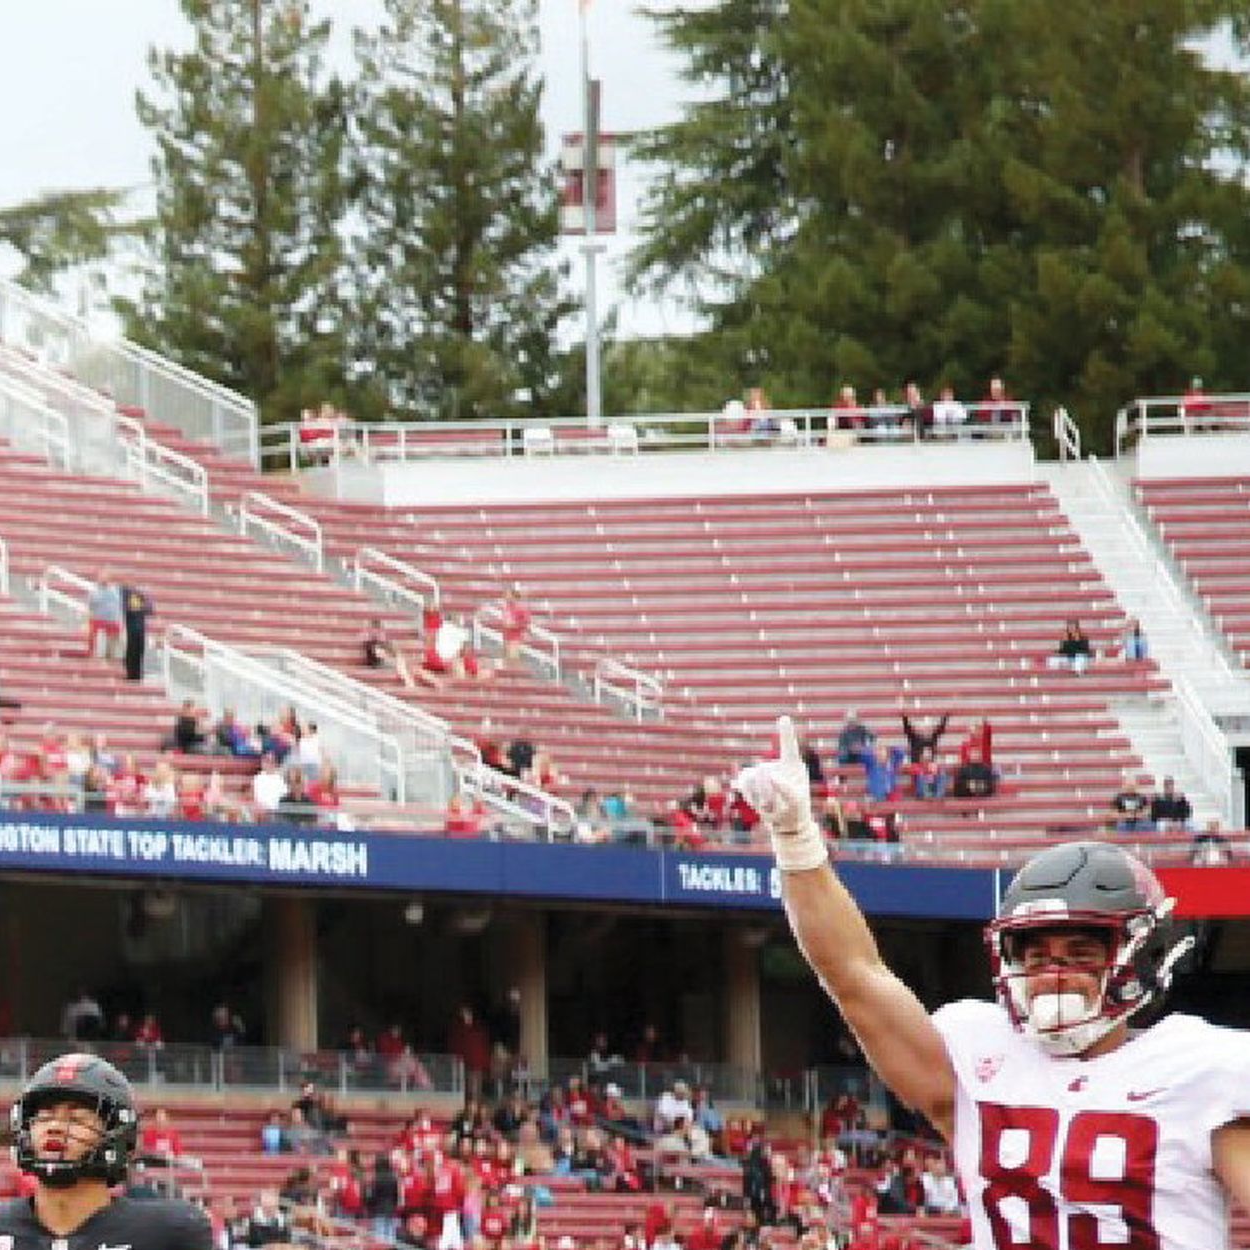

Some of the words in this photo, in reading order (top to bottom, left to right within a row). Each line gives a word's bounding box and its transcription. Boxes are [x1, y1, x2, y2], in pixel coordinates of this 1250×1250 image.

[63, 827, 125, 860] STATE
[128, 829, 167, 861] TOP
[269, 838, 368, 877] MARSH
[678, 863, 761, 894] TACKLES:
